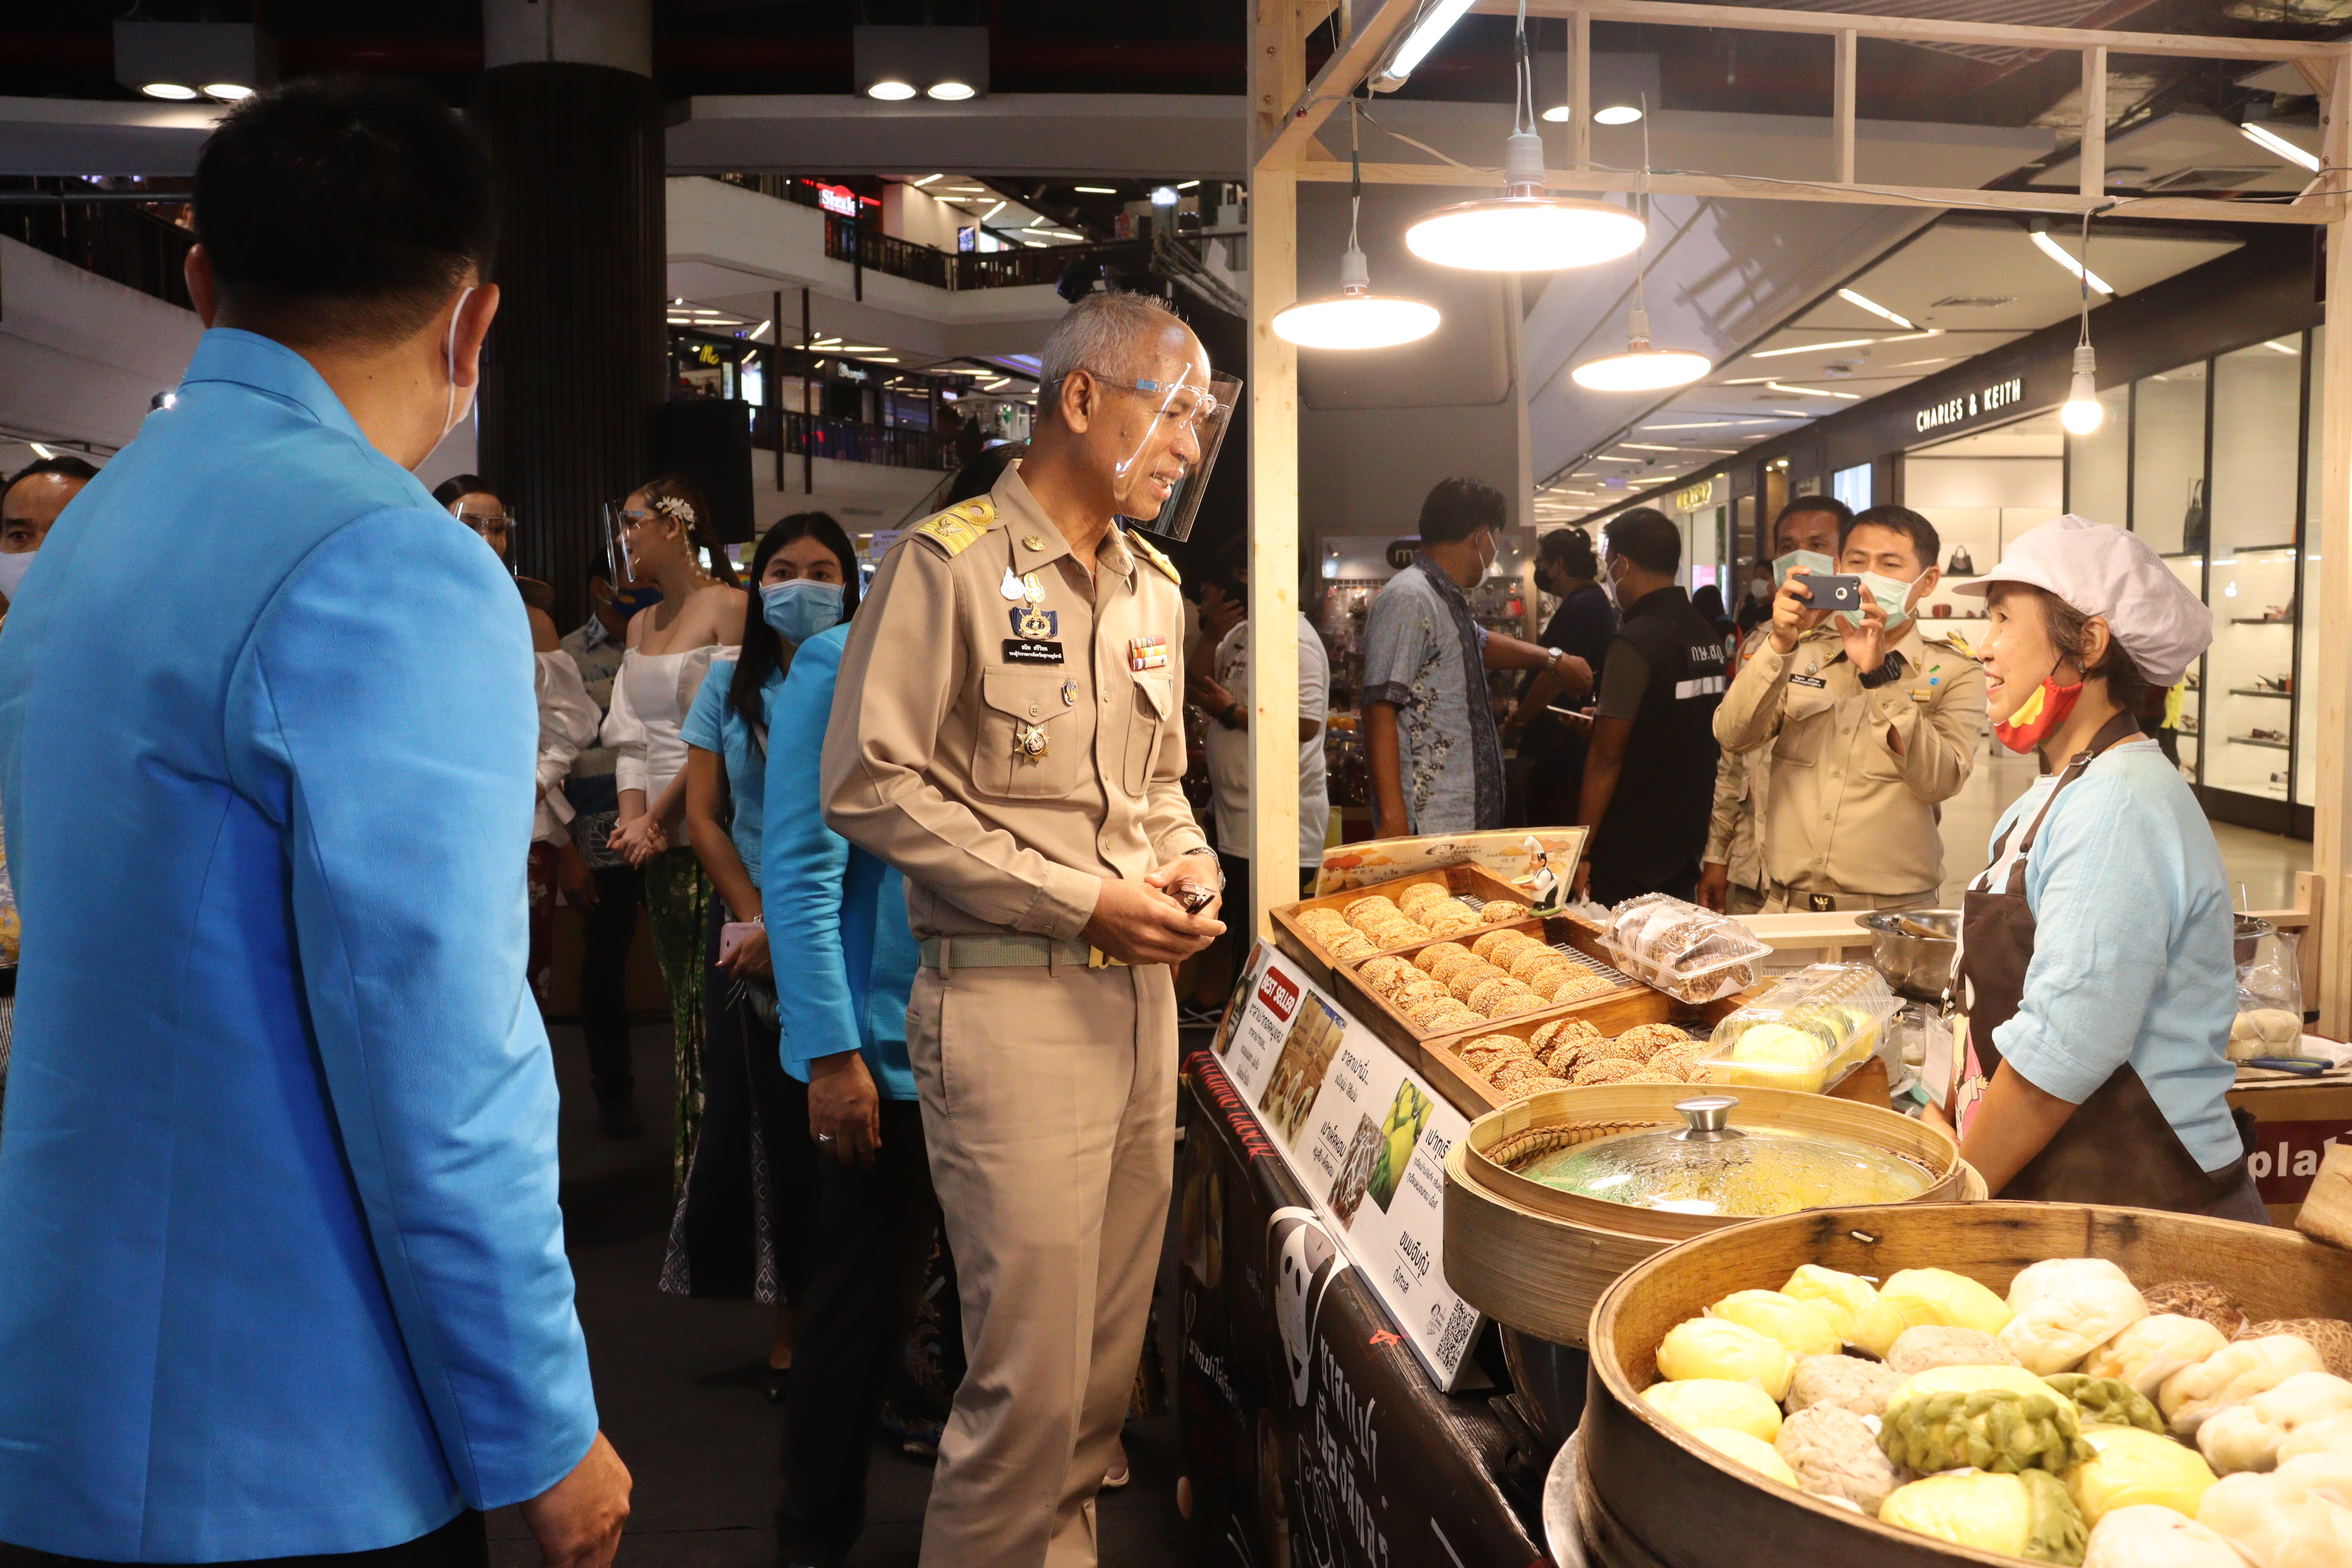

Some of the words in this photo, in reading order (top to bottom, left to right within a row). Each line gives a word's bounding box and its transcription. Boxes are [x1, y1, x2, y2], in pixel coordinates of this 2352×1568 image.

[1916, 397, 1963, 432] CHARLES
[1969, 393, 1977, 416] &
[1984, 378, 2021, 411] KEITH
[1260, 973, 1278, 997] BEST
[1273, 985, 1295, 1015] SELLER
[1321, 1121, 1347, 1158] เปาเห็ดหอม
[1425, 1129, 1451, 1160] เปาทุเรี
[2248, 1136, 2337, 1184] pla
[1400, 1231, 1430, 1279] ขนมจีบกุ้ง
[1393, 1265, 1410, 1294] กุ้งทะเล
